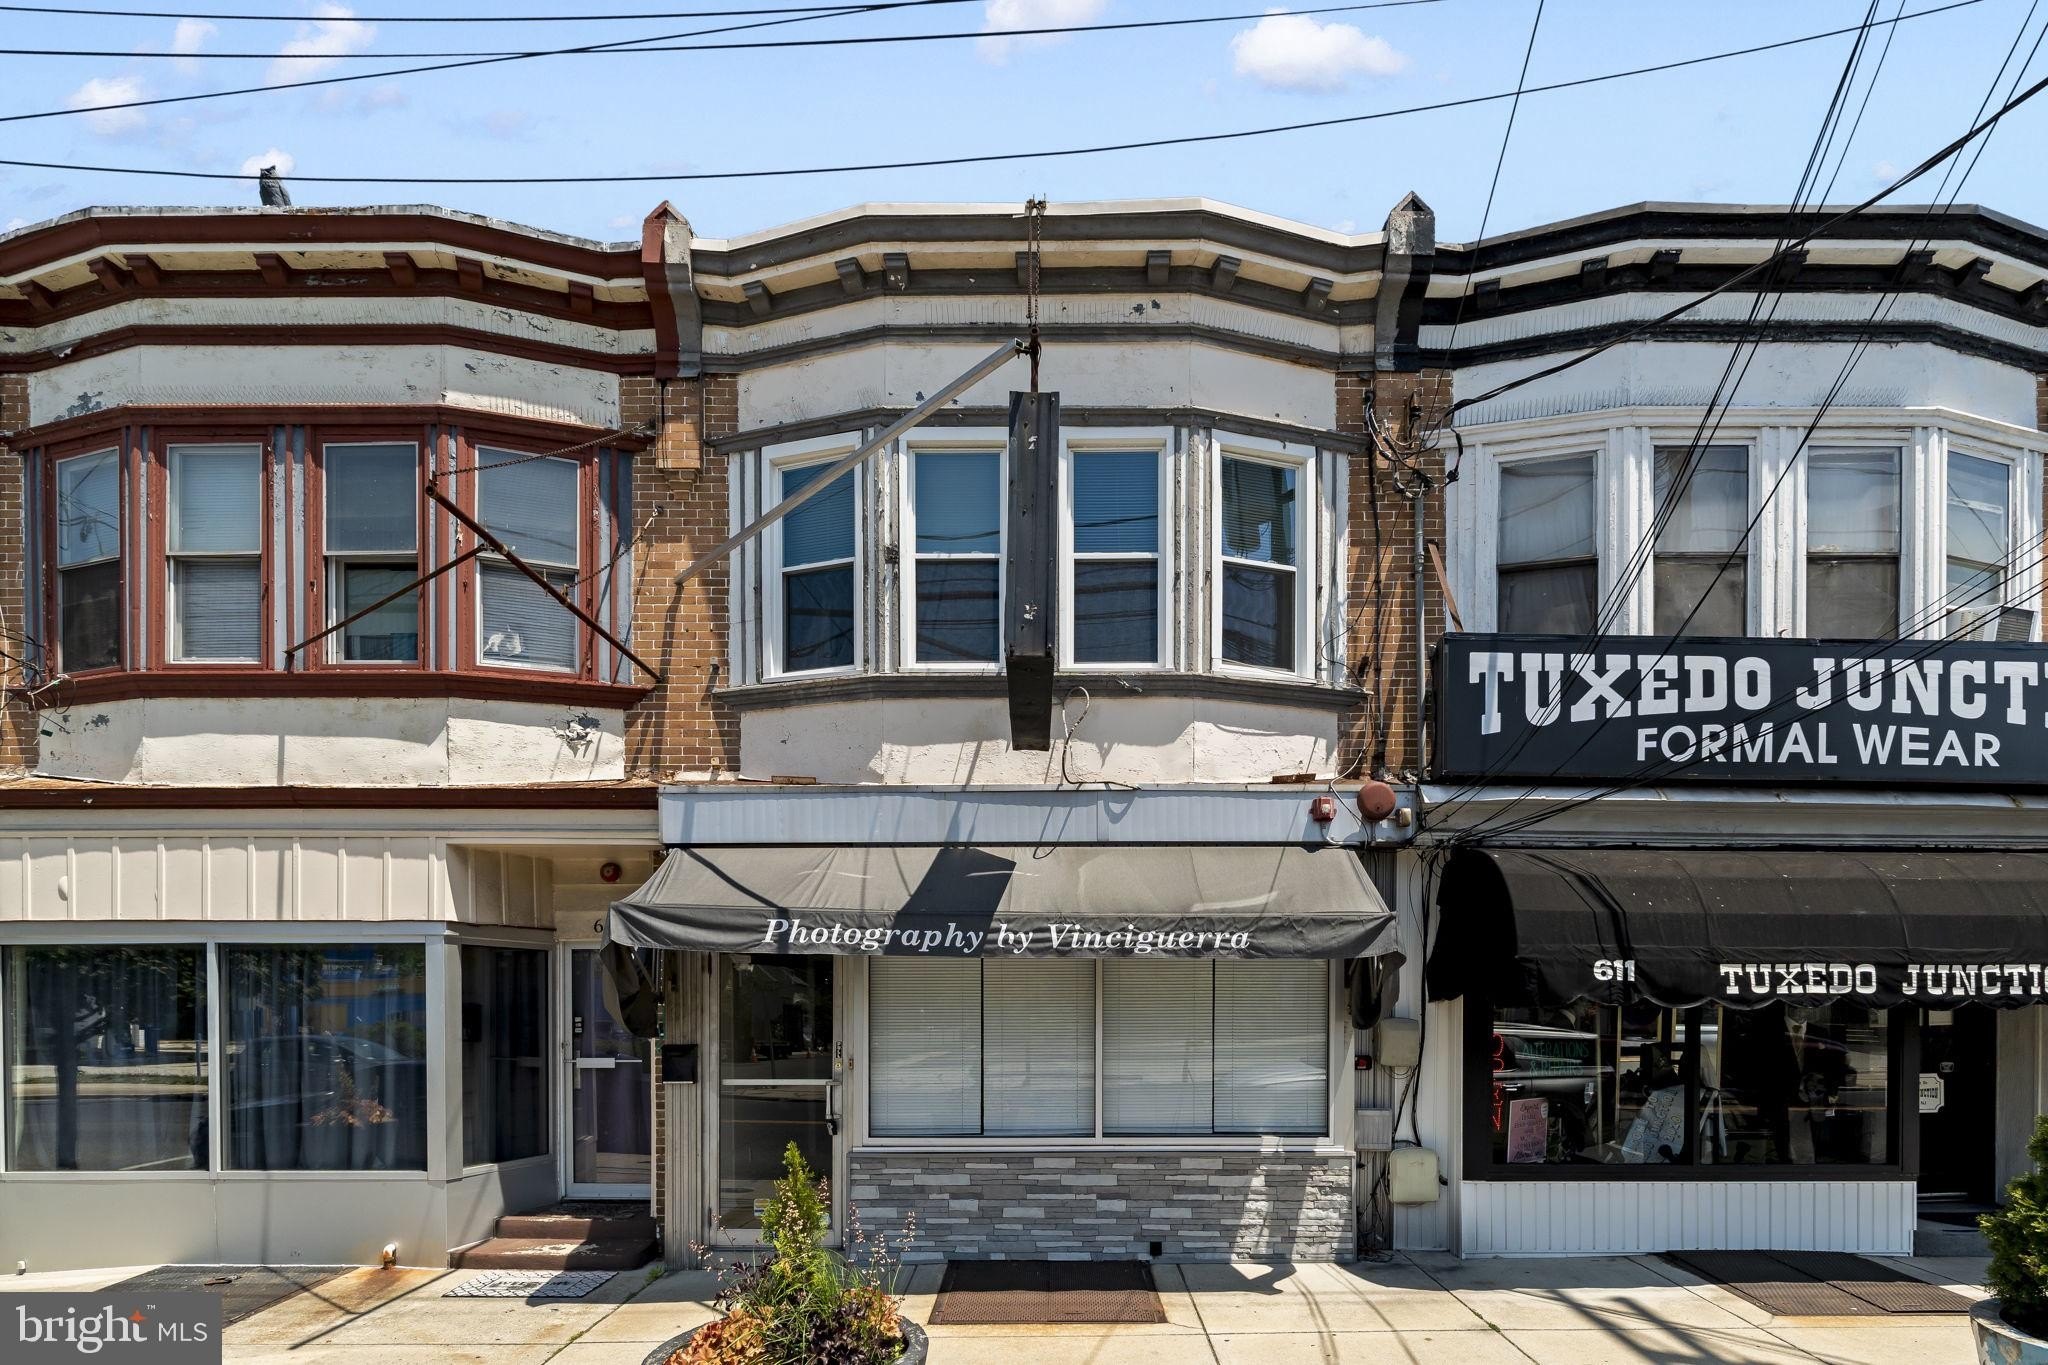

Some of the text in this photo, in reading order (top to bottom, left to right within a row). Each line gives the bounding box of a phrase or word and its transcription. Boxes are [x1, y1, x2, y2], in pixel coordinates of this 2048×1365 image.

[1469, 651, 2048, 735] TUXEDO JUNCT
[1637, 722, 2001, 767] FORMAL WEAR
[762, 918, 1250, 954] Photography by Vinciguerra
[1593, 959, 1636, 982] 611
[1719, 962, 2048, 996] TUXEDO JUNCTI
